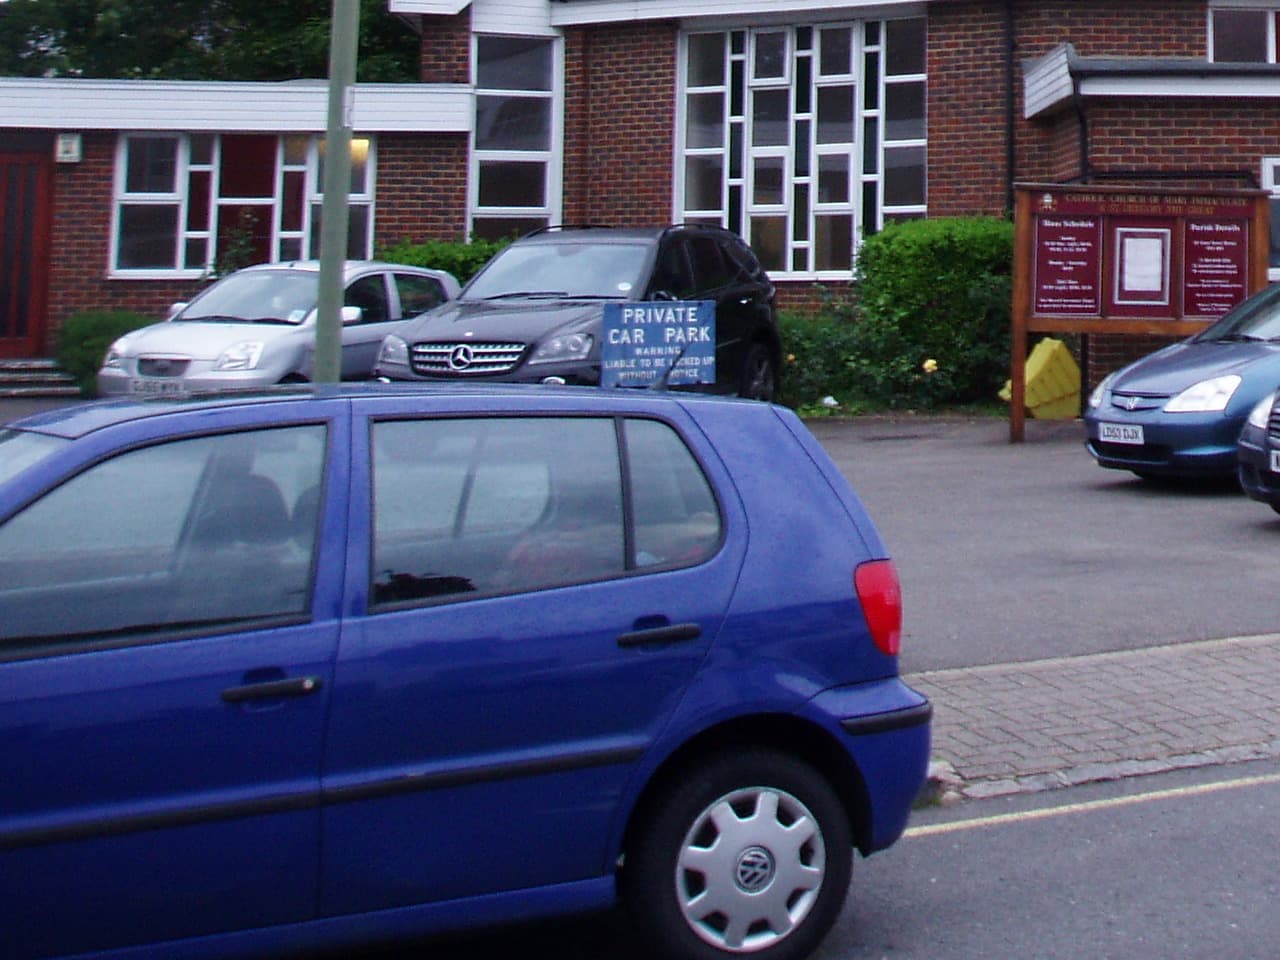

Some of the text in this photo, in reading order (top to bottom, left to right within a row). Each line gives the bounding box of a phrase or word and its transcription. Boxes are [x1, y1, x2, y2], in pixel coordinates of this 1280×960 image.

[1063, 219, 1095, 228] Schedule
[1190, 223, 1241, 232] Parish Details
[623, 306, 699, 324] PRIVATE
[609, 326, 711, 344] CAR PARK
[635, 346, 682, 356] WARNING
[604, 359, 637, 369] LIABLE
[640, 358, 652, 368] TO
[654, 358, 667, 368] BE
